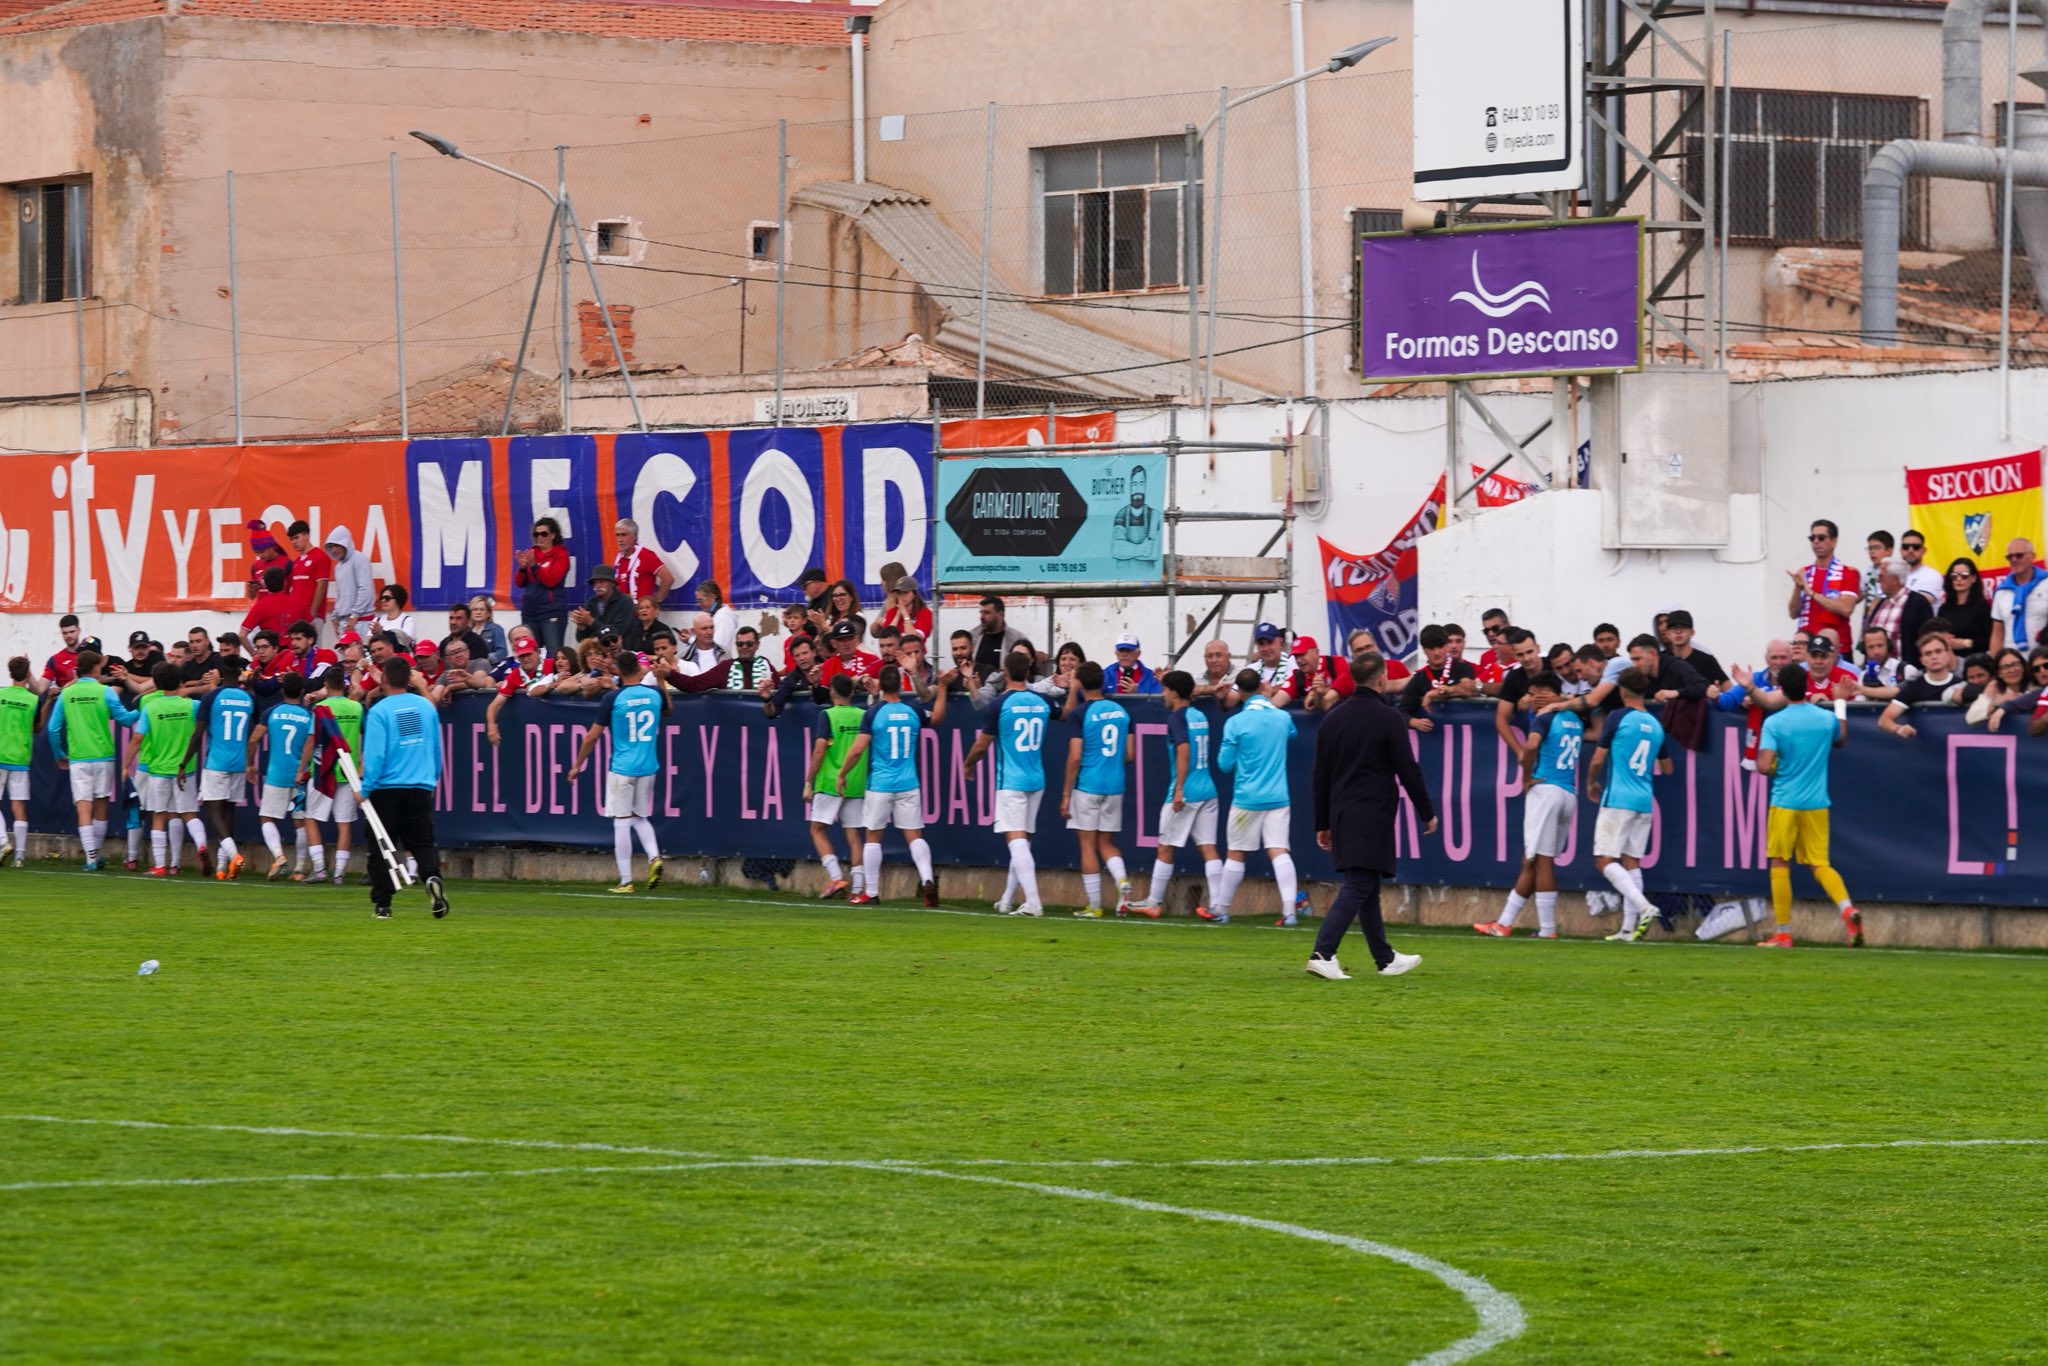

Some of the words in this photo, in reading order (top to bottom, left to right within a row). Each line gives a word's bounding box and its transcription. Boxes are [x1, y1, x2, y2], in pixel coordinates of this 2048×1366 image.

[1502, 107, 1519, 123] 644
[1521, 105, 1533, 121] 30
[1535, 104, 1546, 120] 10
[1547, 103, 1560, 119] 93
[1502, 132, 1556, 153] inyecla.com
[1385, 331, 1480, 360] Formas
[1487, 326, 1619, 356] Descanso
[1091, 477, 1125, 496] BUTCHER
[1927, 462, 2022, 501] SECCION
[973, 492, 1023, 519] CARMELO
[1024, 492, 1061, 519] PUCHE
[219, 710, 248, 742] 17
[281, 724, 298, 755] 7
[625, 710, 655, 742] 12
[1013, 717, 1043, 752] 20
[1101, 723, 1119, 757] 9
[887, 726, 911, 759] 11
[1628, 739, 1650, 777] 4
[471, 723, 507, 813] EL
[524, 724, 682, 818] DEPOE
[700, 725, 720, 819] Y
[740, 725, 784, 821] LA
